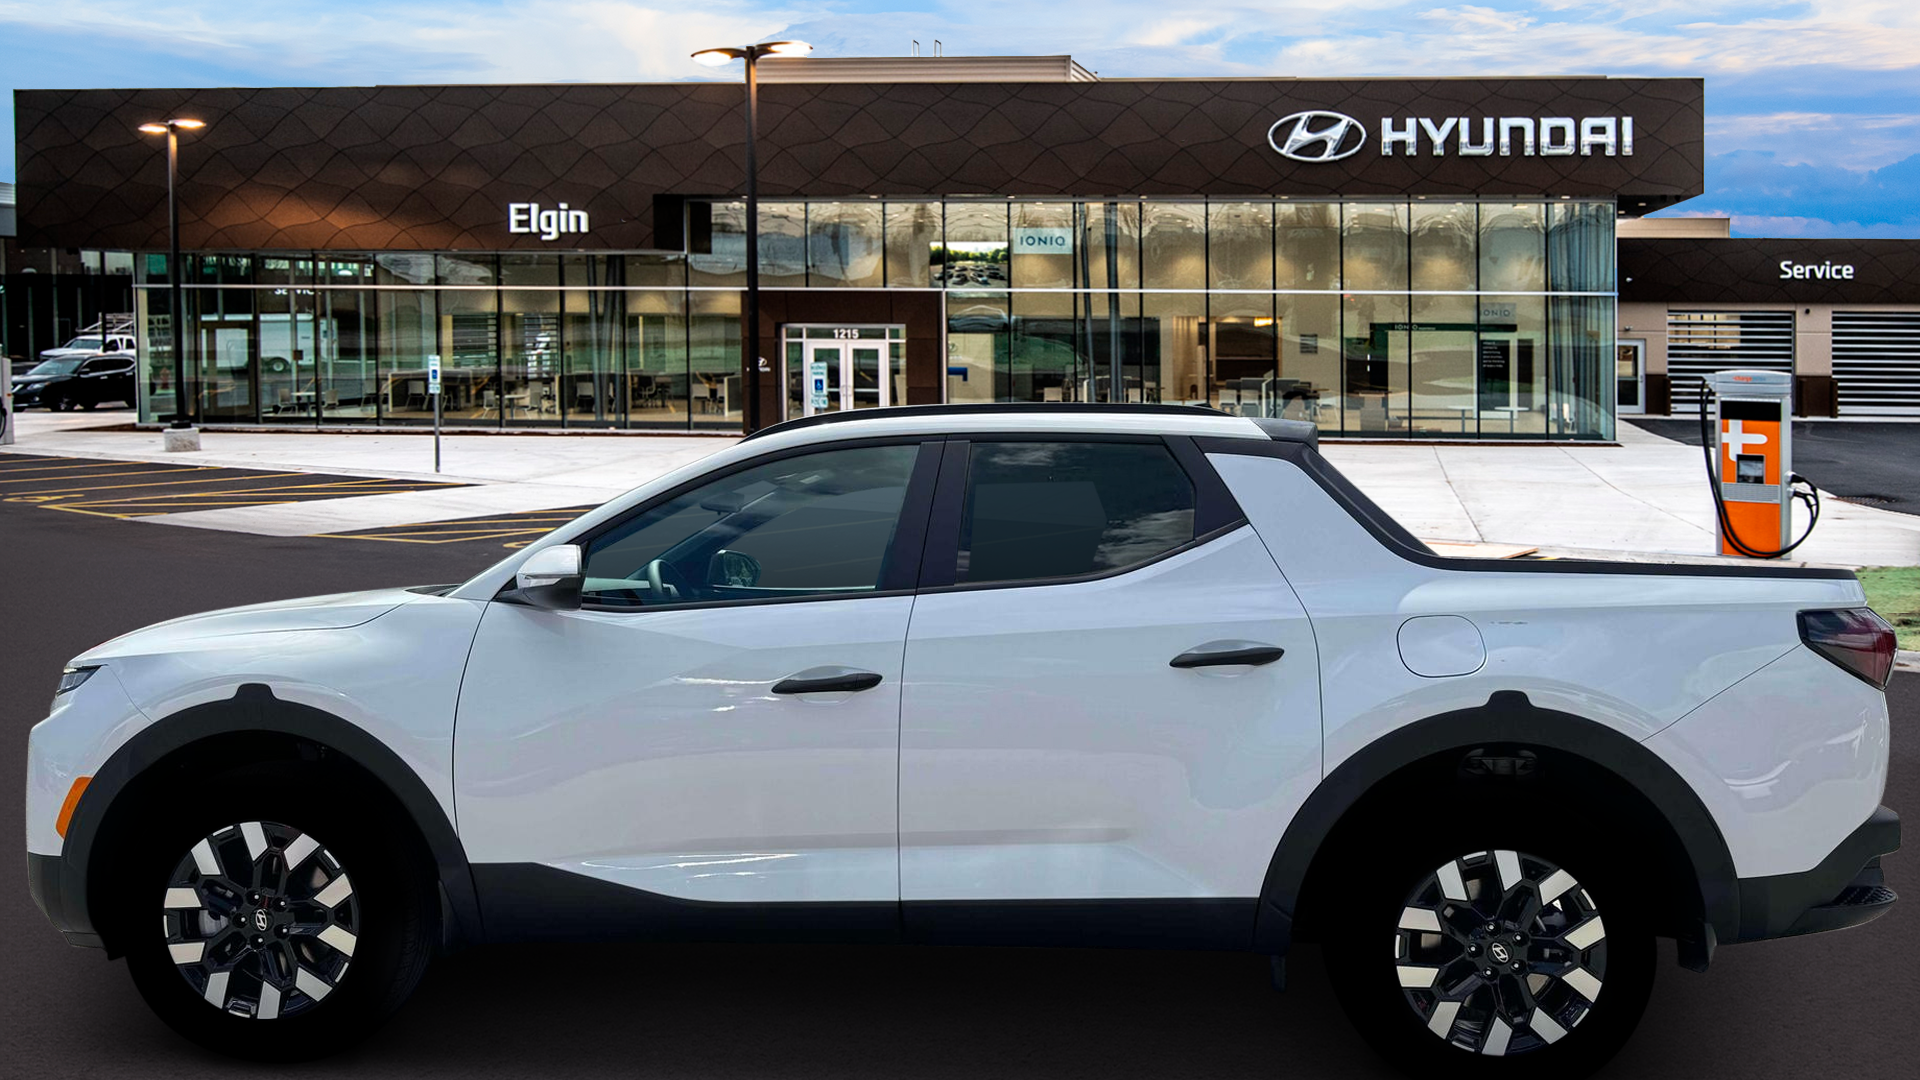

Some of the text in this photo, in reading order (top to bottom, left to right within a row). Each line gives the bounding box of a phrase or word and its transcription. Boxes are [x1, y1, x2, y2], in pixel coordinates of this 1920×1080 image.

[1381, 116, 1634, 156] HYUNDAI
[508, 202, 590, 241] Elgin
[1020, 235, 1066, 247] IONIQ
[1779, 260, 1855, 280] Service
[833, 329, 860, 339] 1215
